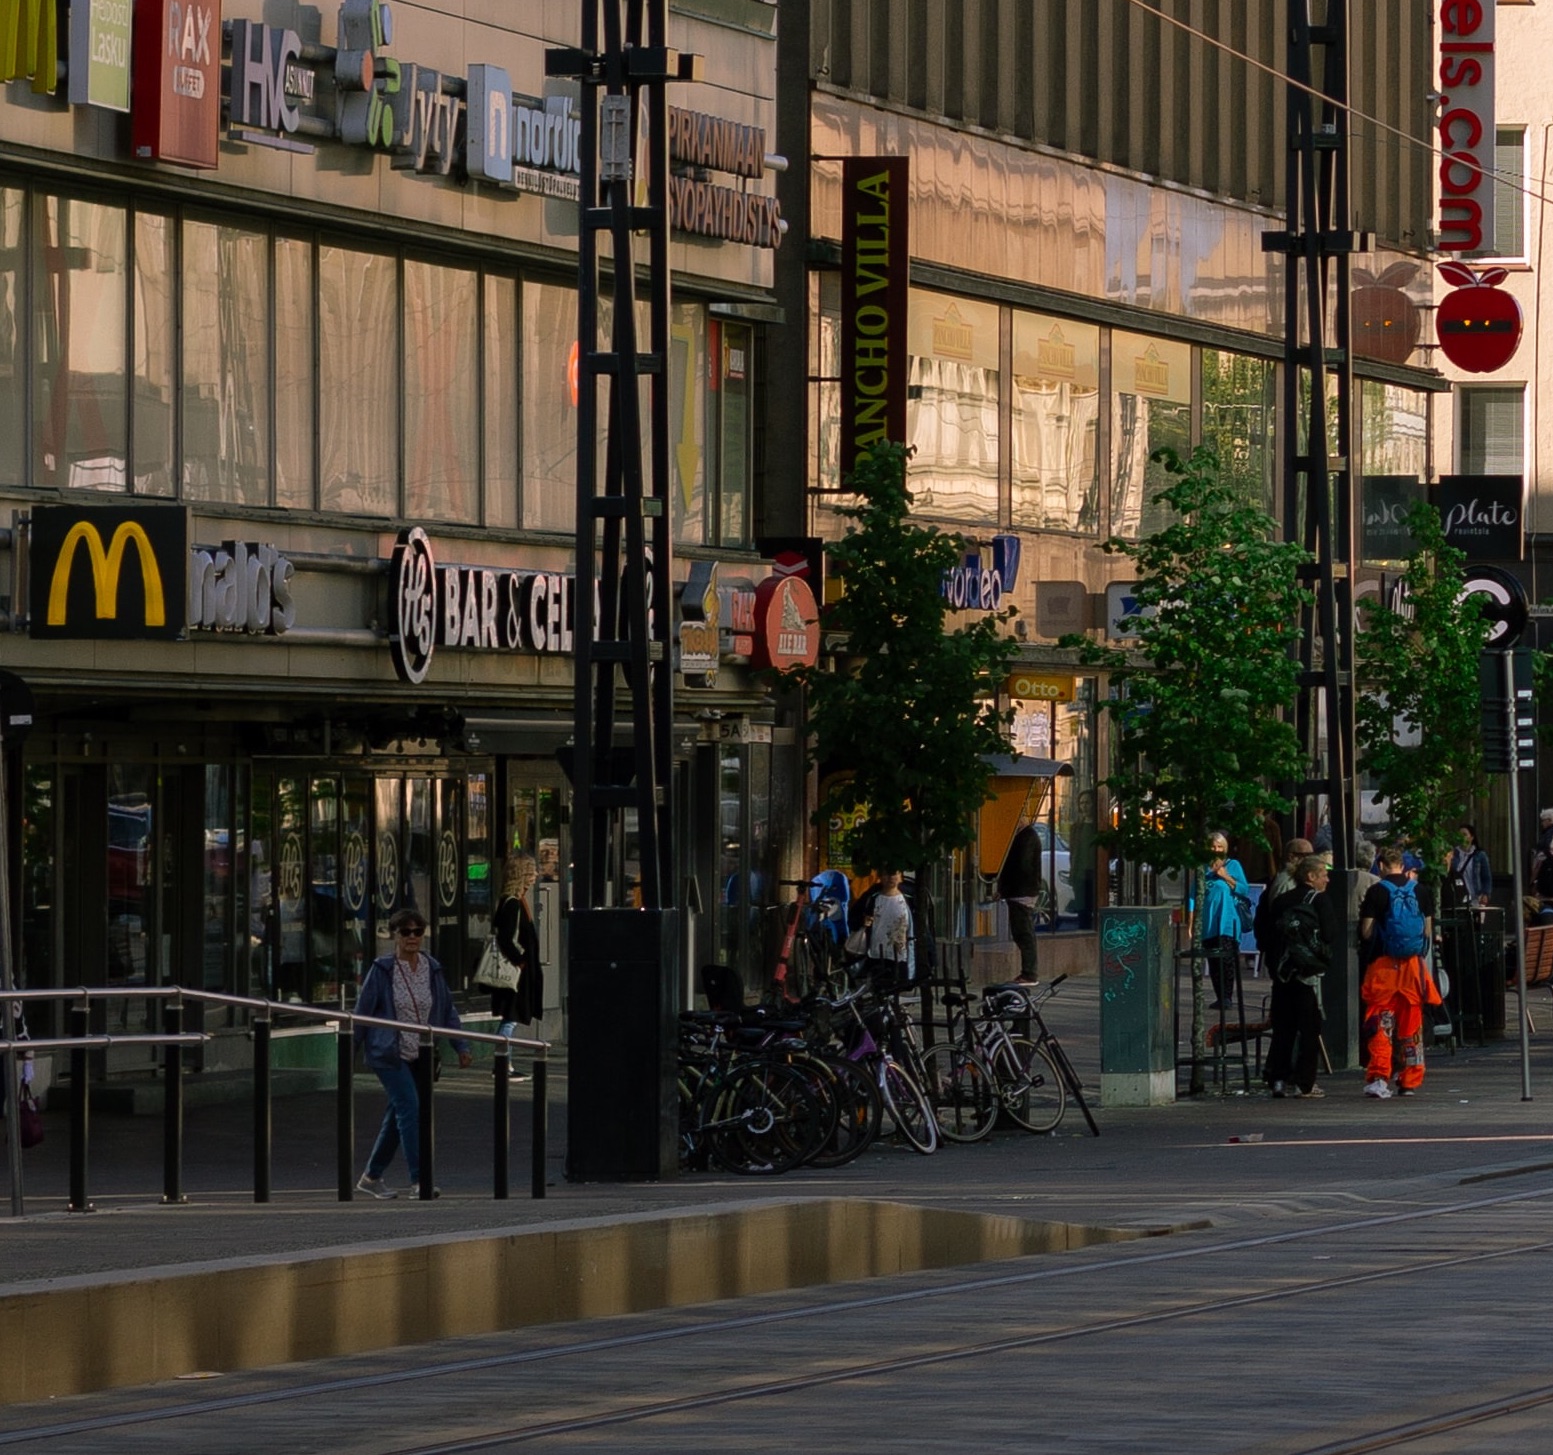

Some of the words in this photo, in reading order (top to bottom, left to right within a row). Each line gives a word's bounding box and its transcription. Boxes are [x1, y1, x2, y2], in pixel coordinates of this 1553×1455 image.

[91, 31, 127, 68] Lasku
[168, 0, 212, 66] RAX
[668, 106, 767, 179] PIRKANMAAN
[855, 169, 890, 299] VILLA
[1443, 497, 1518, 537] plate
[445, 567, 499, 649] BAR
[507, 572, 523, 650] &
[720, 724, 740, 738] 5A
